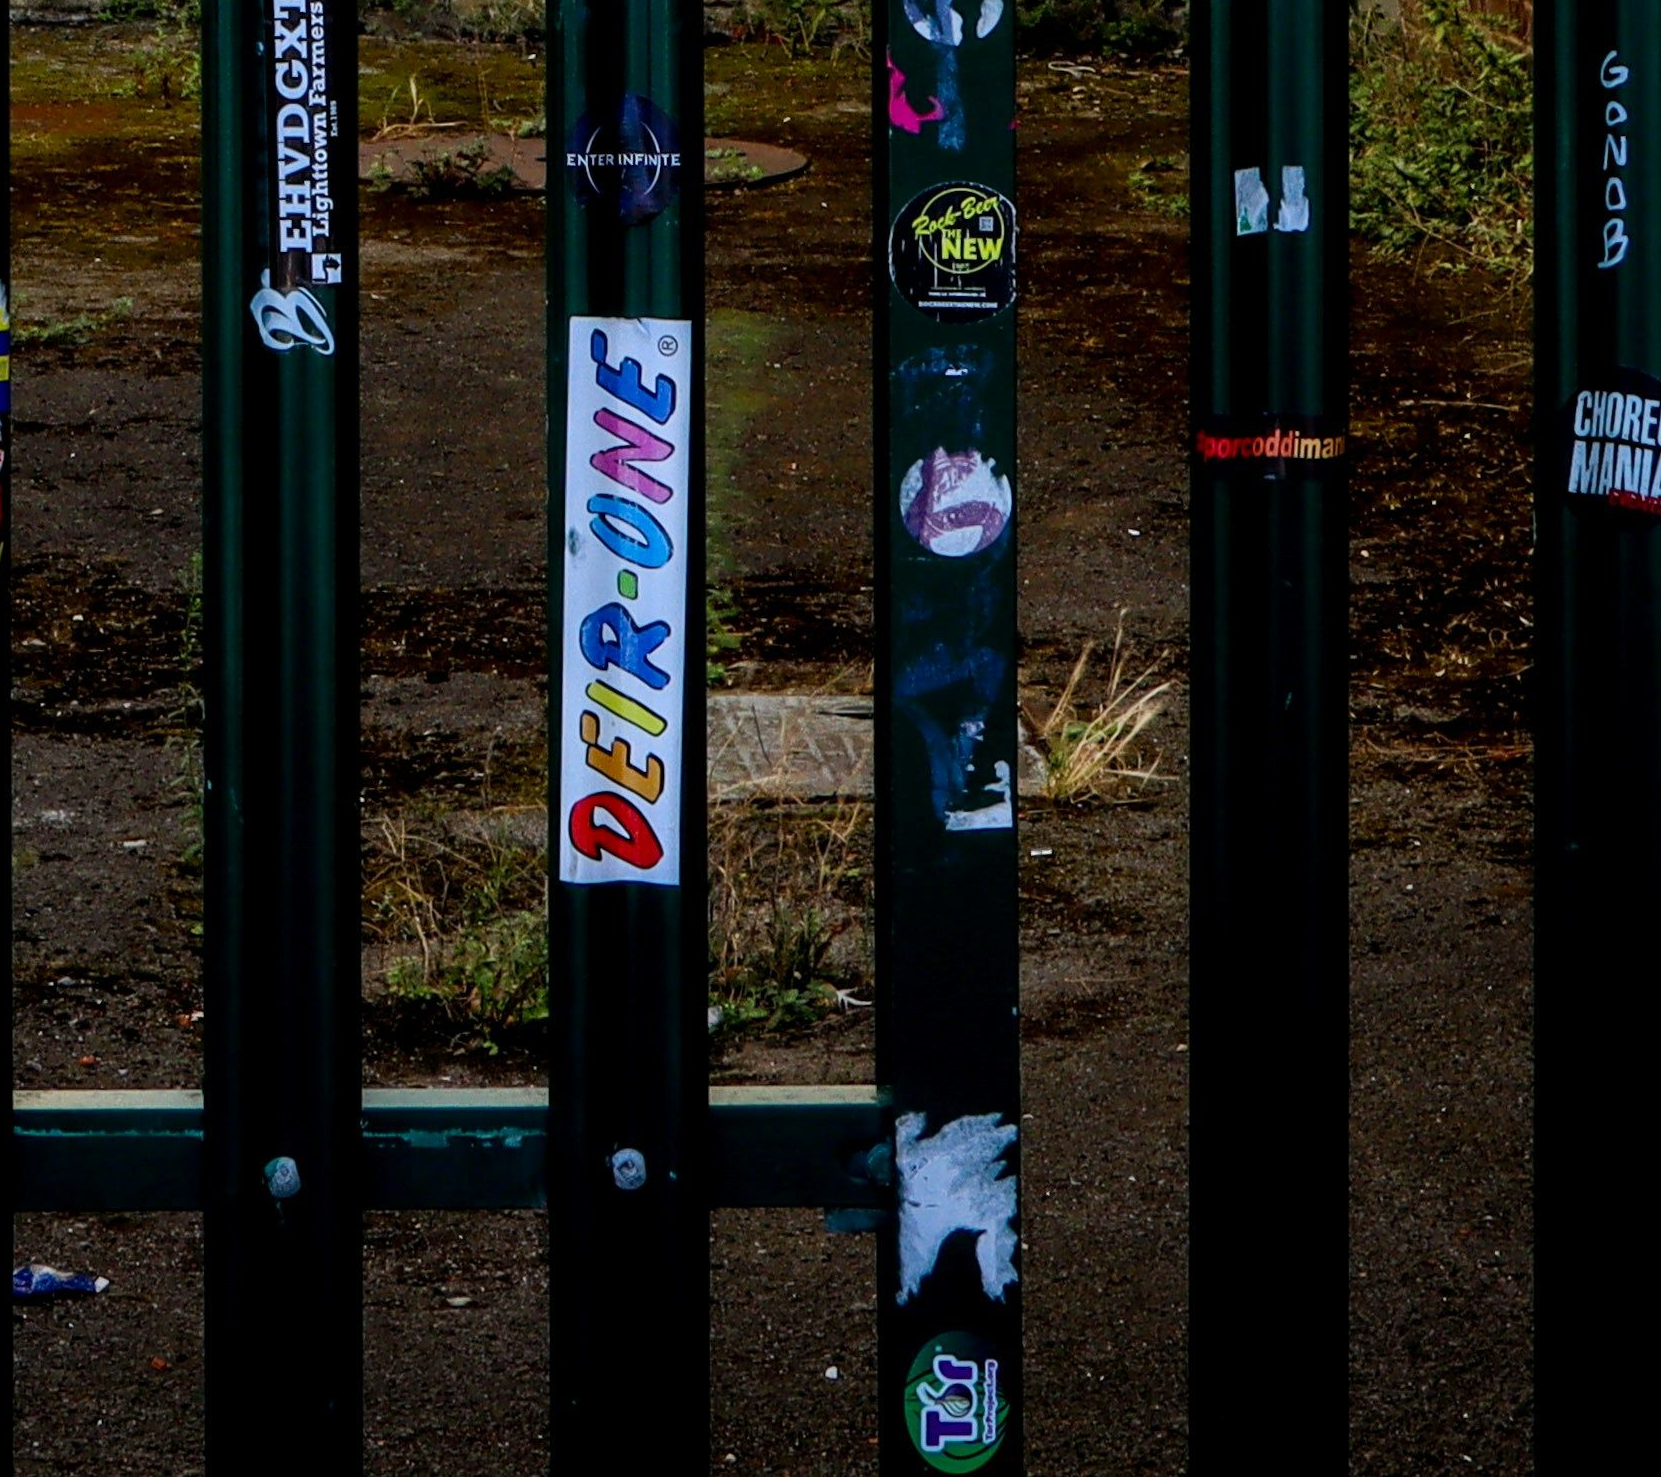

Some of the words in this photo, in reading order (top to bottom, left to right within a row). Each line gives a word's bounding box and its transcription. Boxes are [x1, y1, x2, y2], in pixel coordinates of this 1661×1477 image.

[309, 113, 332, 239] Lighttown
[566, 152, 615, 167] ENTER
[617, 152, 681, 168] INFINITE
[940, 237, 1001, 264] NEW
[568, 329, 679, 872] DEIR-ONE
